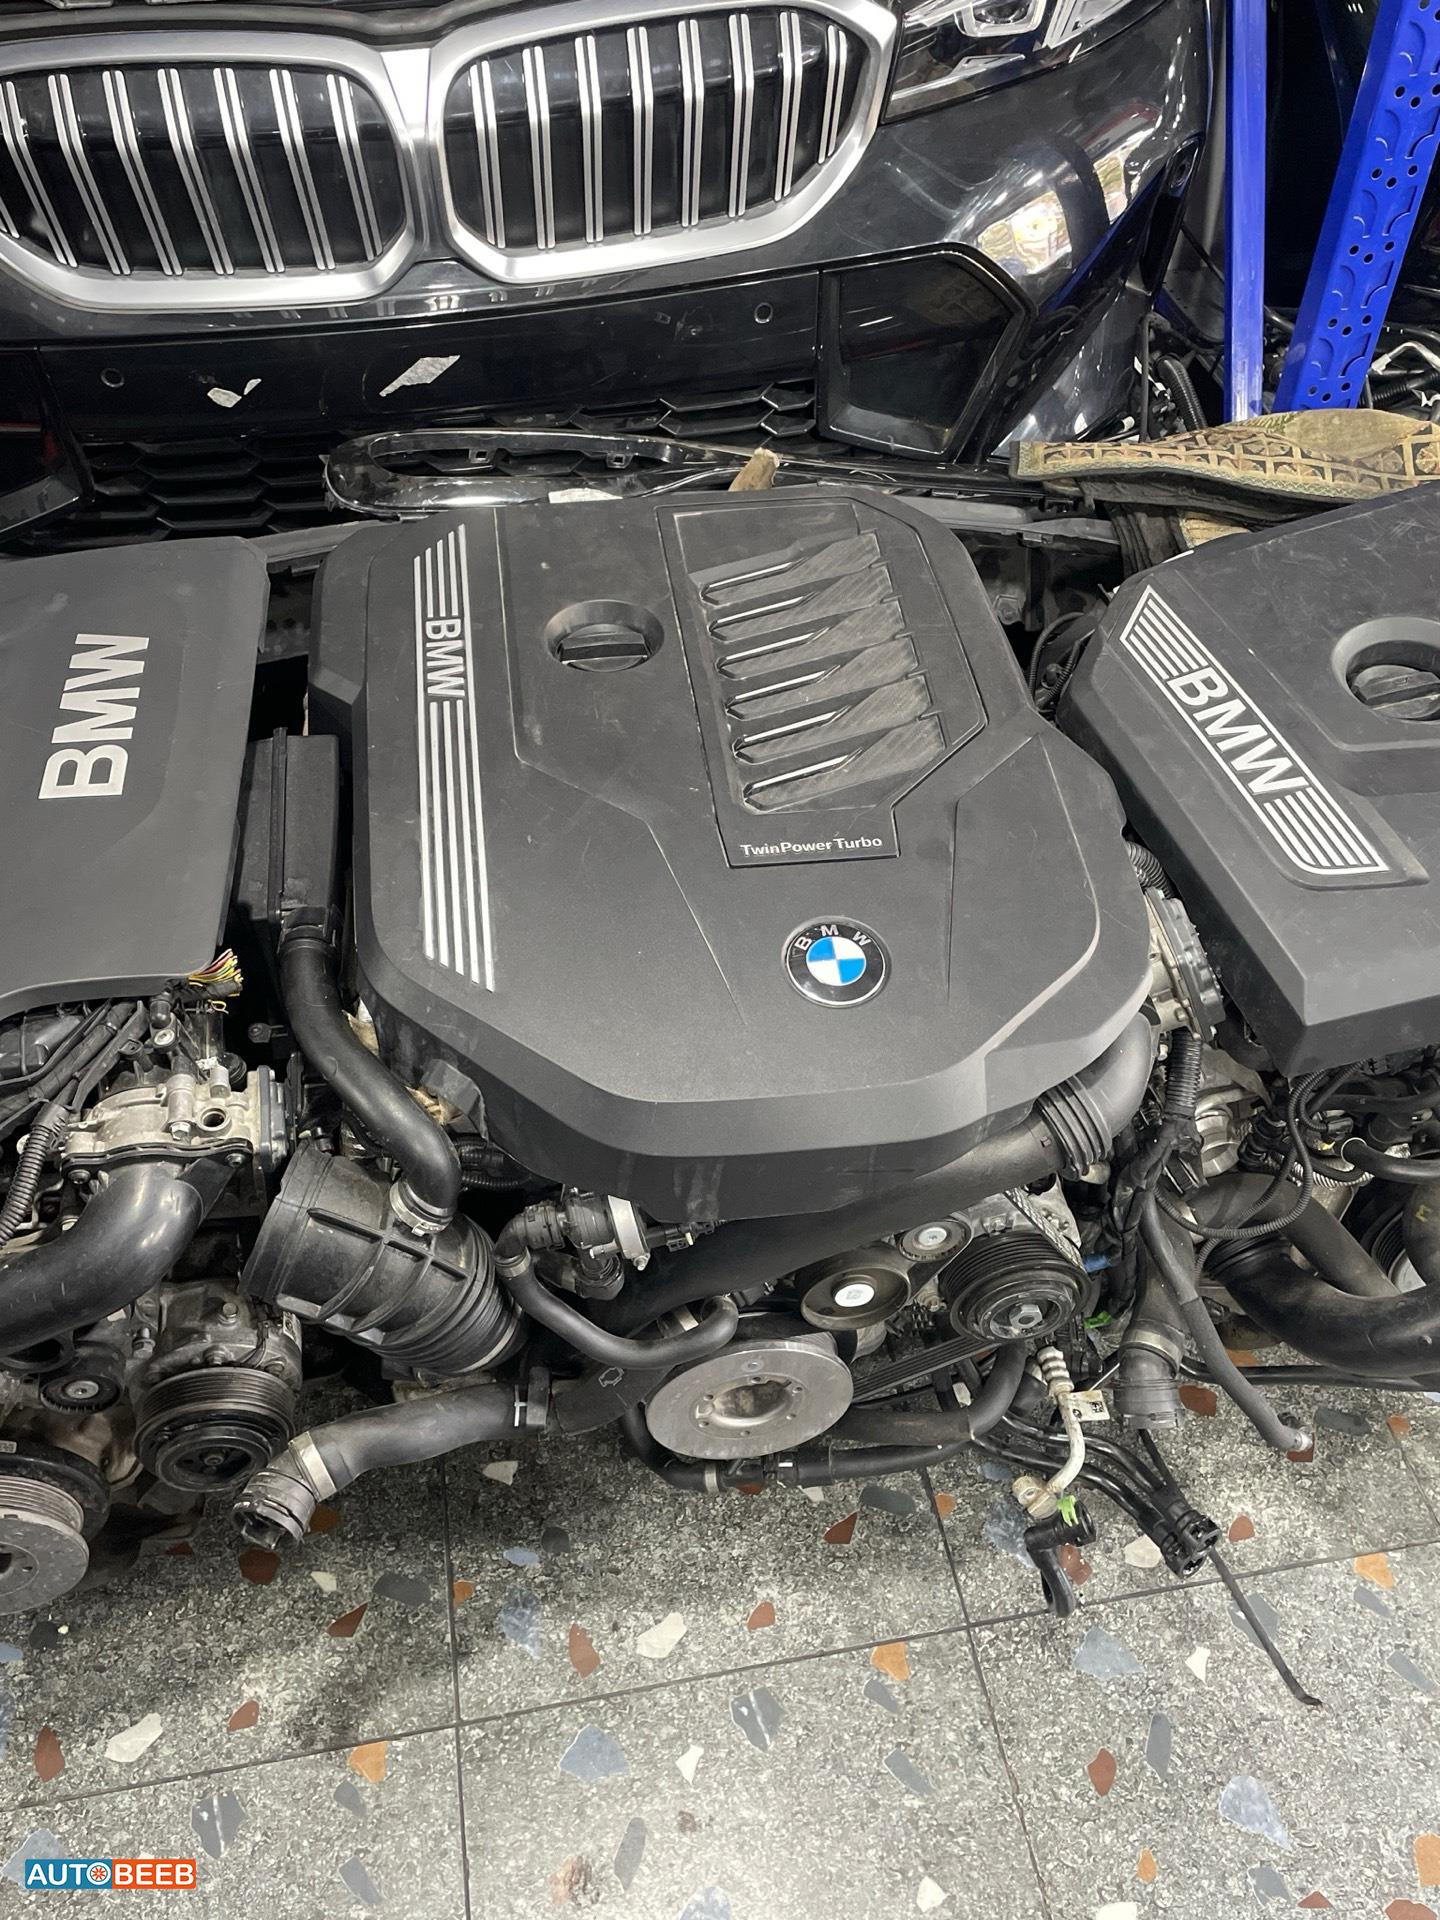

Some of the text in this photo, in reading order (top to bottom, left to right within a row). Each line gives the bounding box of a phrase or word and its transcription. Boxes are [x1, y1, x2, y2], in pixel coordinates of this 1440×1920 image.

[425, 618, 465, 698] BMW
[38, 633, 150, 799] BMW
[1165, 666, 1311, 795] BMW
[834, 837, 882, 849] Turbo
[795, 925, 871, 950] BMW
